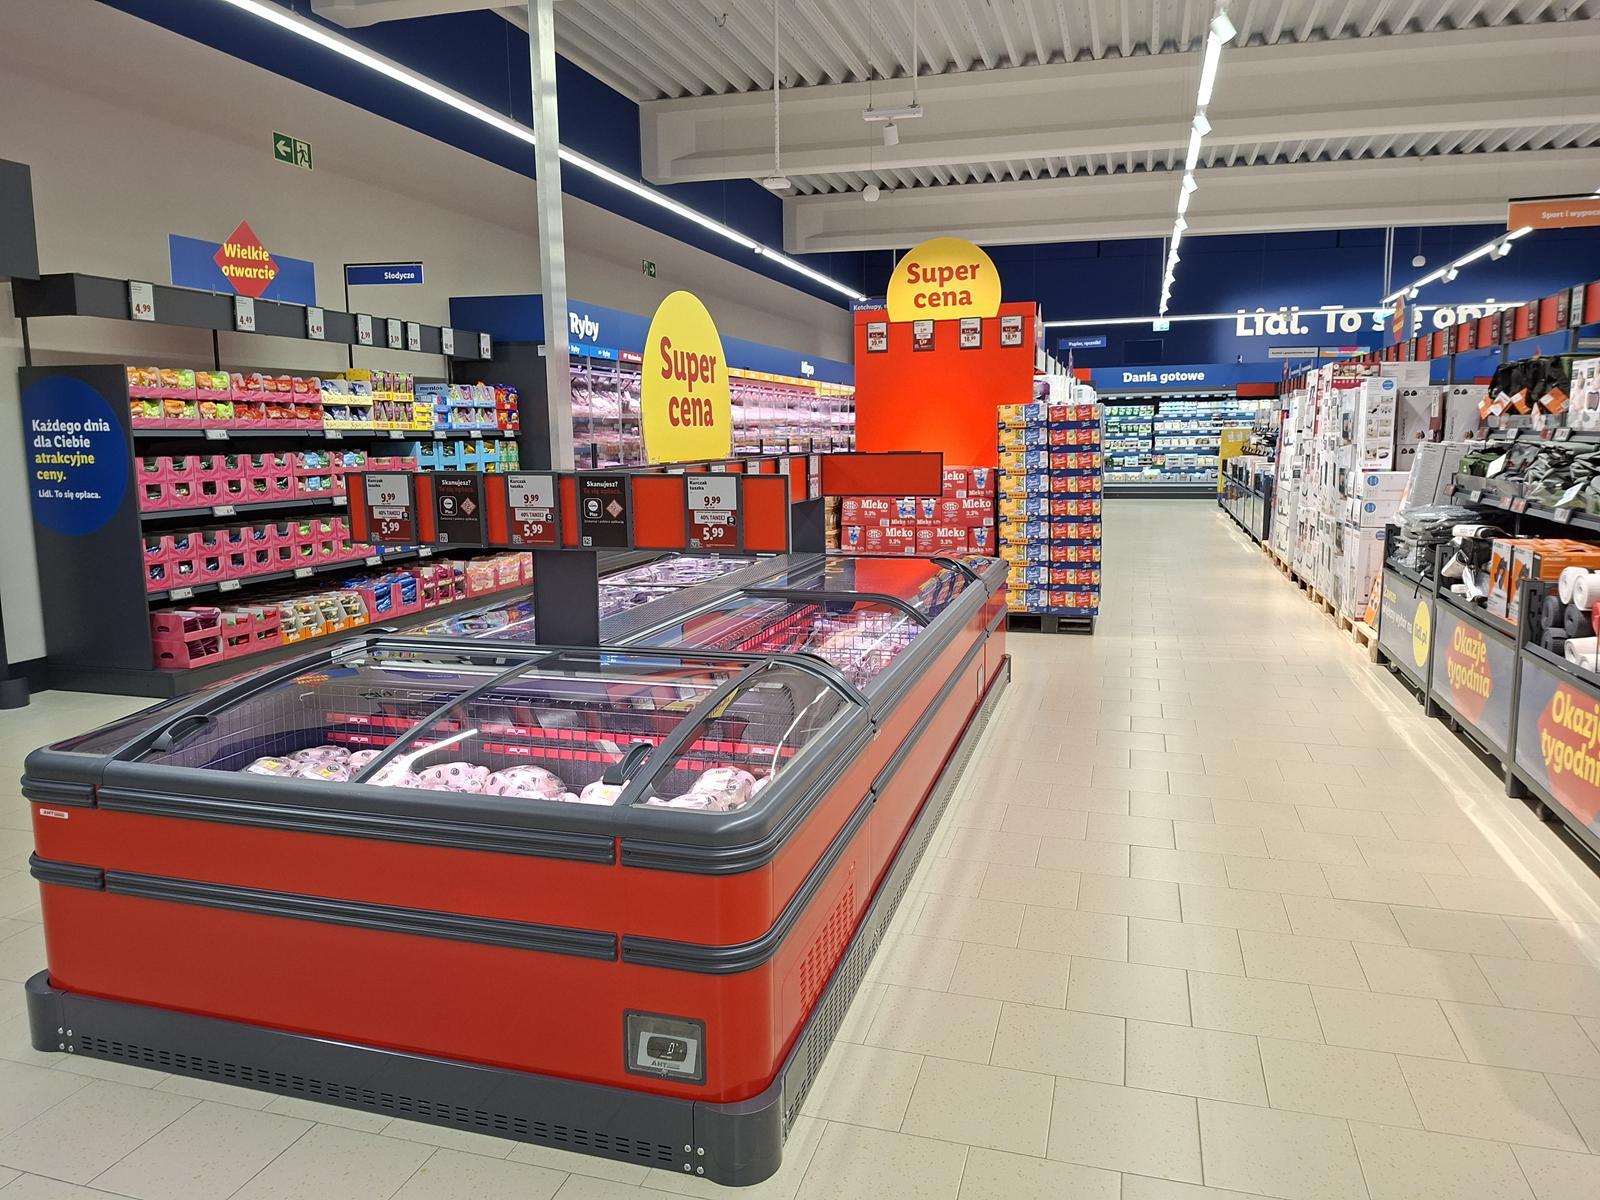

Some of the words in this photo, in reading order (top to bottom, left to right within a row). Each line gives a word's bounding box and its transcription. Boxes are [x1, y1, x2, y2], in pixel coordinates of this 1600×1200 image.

[1542, 211, 1564, 219] Sport
[223, 242, 269, 261] Wielkie
[221, 264, 275, 280] otwarcie
[384, 272, 415, 281] Słodycze
[906, 262, 980, 288] Super
[914, 289, 972, 309] cena
[569, 312, 599, 342] Ryby
[1236, 306, 1309, 337] Lidl.
[1320, 305, 1362, 334] To
[660, 336, 716, 392] Super
[1122, 371, 1158, 383] Dania
[1160, 371, 1205, 384] gotowe
[668, 396, 714, 427] cena
[31, 419, 82, 435] Każdego
[83, 418, 111, 432] dnia
[33, 435, 52, 448] dla
[54, 435, 91, 448] Ciebie
[35, 451, 95, 467] atrakcyjne
[36, 470, 67, 483] ceny.
[943, 470, 965, 481] leko
[586, 480, 618, 488] Skanujesz?
[54, 489, 63, 498] To
[381, 493, 395, 502] 9.99
[523, 494, 539, 504] 9.99
[703, 496, 721, 506] 9.99
[861, 499, 889, 509] Mleko
[962, 499, 991, 508] Mleko
[381, 522, 400, 534] 5.99
[523, 524, 543, 536] 5.99
[703, 527, 724, 540] 5.99
[885, 527, 913, 537] Mleko
[936, 527, 965, 537] Mleko
[1454, 625, 1487, 667] Okazje
[1447, 655, 1491, 699] tygodnia
[1552, 690, 1600, 749] Okazj
